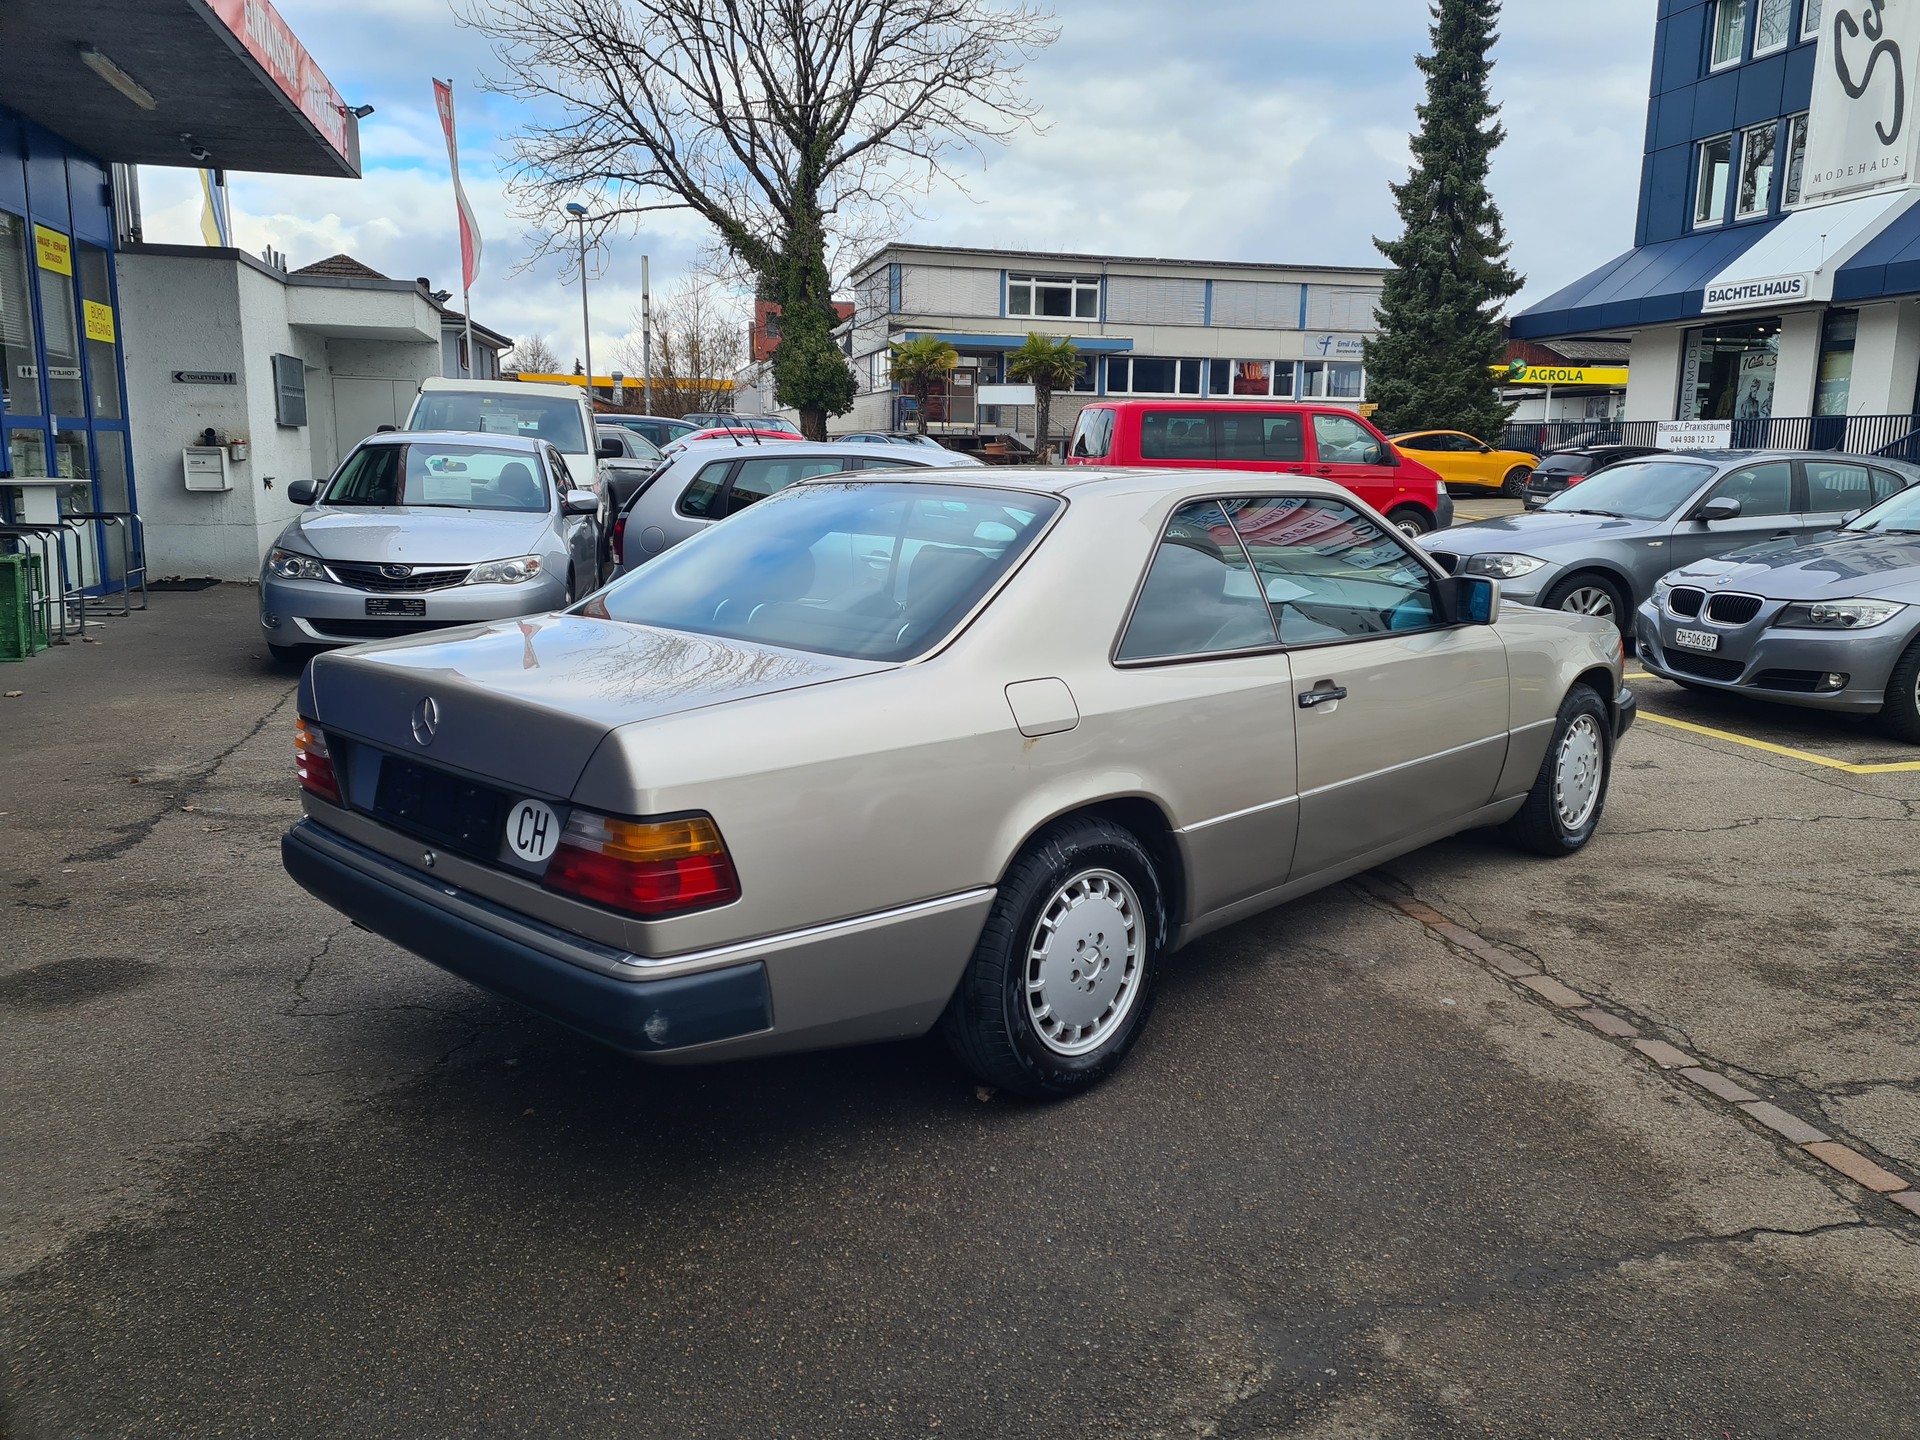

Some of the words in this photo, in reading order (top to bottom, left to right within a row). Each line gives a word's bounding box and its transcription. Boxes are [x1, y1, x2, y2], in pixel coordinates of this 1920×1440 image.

[244, 0, 297, 89] EINTAUSCH
[1812, 155, 1900, 184] MODEHAUS
[1708, 279, 1801, 303] BACHTELHAUS
[90, 304, 106, 321] BÜRO
[88, 319, 112, 337] EINGANG
[1528, 369, 1584, 381] AGROLA
[1682, 339, 1699, 421] AMENMODE
[1658, 422, 1679, 432] Büros
[1684, 421, 1731, 431] Praxisräume
[1670, 435, 1682, 444] 044
[1683, 435, 1696, 444] 938
[1697, 435, 1705, 444] 12
[1706, 435, 1715, 444] 12
[516, 806, 550, 857] CH
